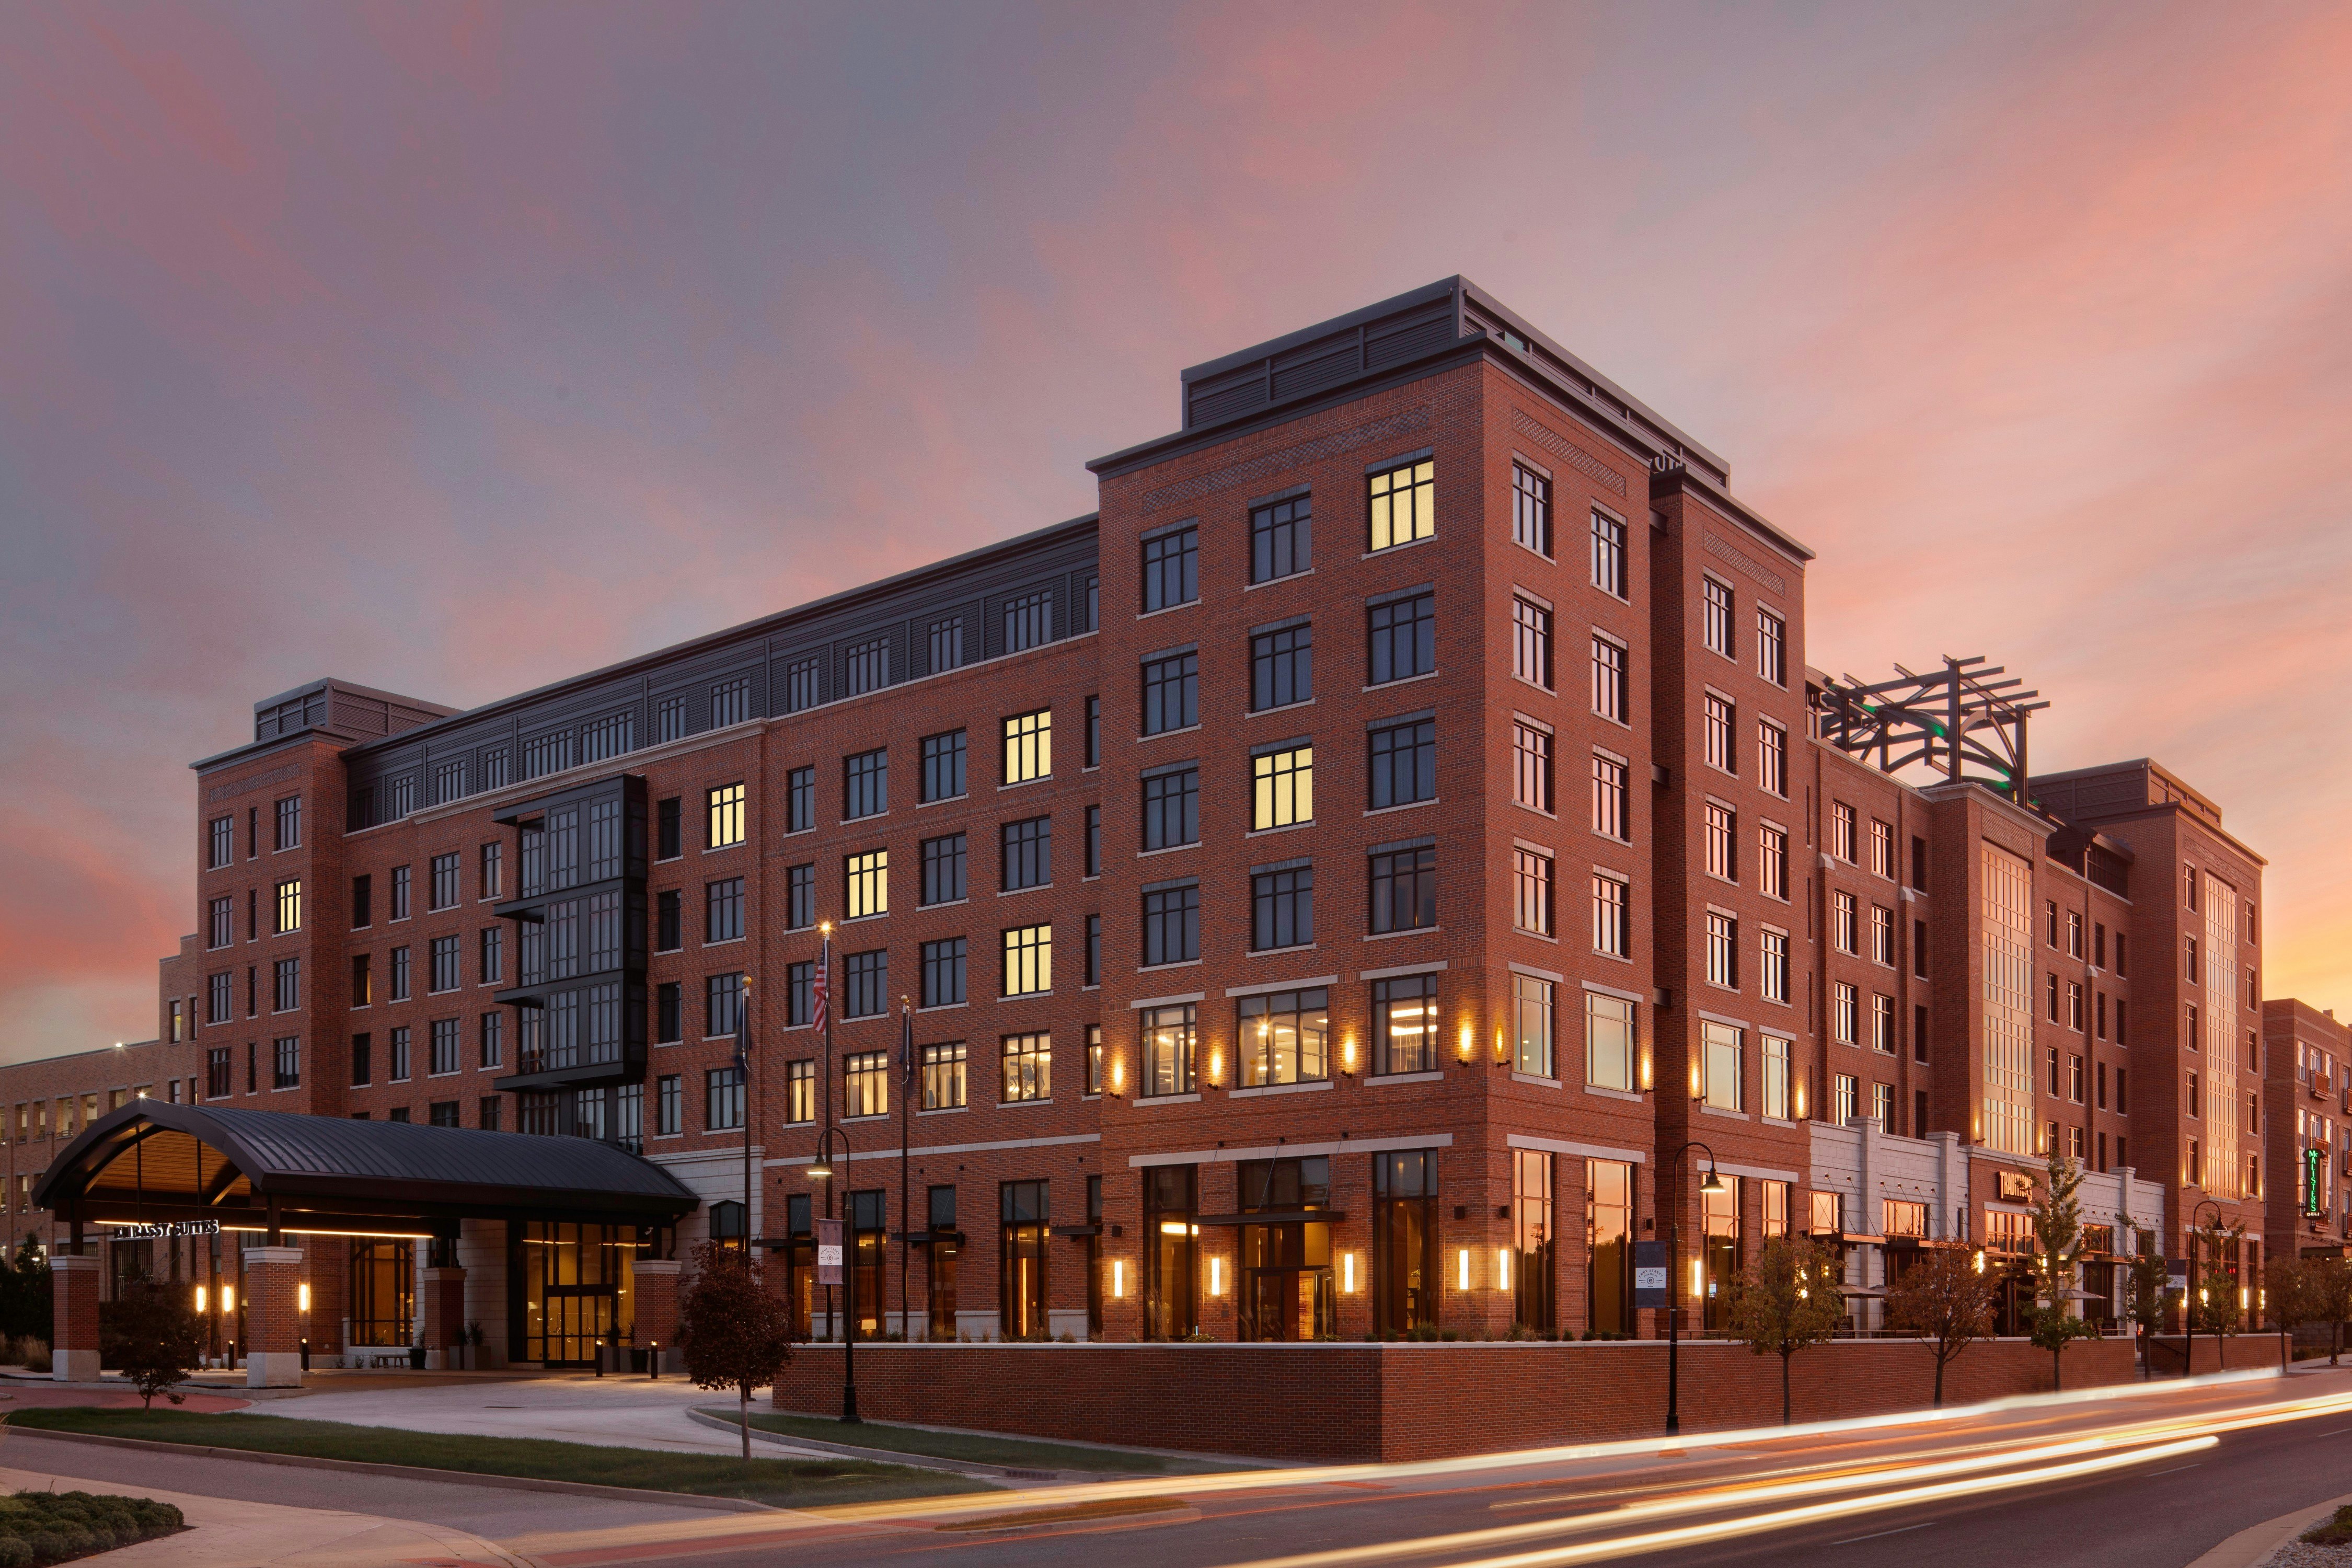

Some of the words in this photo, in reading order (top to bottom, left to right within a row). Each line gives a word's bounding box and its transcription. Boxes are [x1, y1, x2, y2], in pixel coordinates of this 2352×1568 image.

[174, 1219, 220, 1236] SUITES
[828, 1247, 840, 1255] STREET
[1638, 1269, 1648, 1278] EDDY
[1648, 1269, 1663, 1277] STREET
